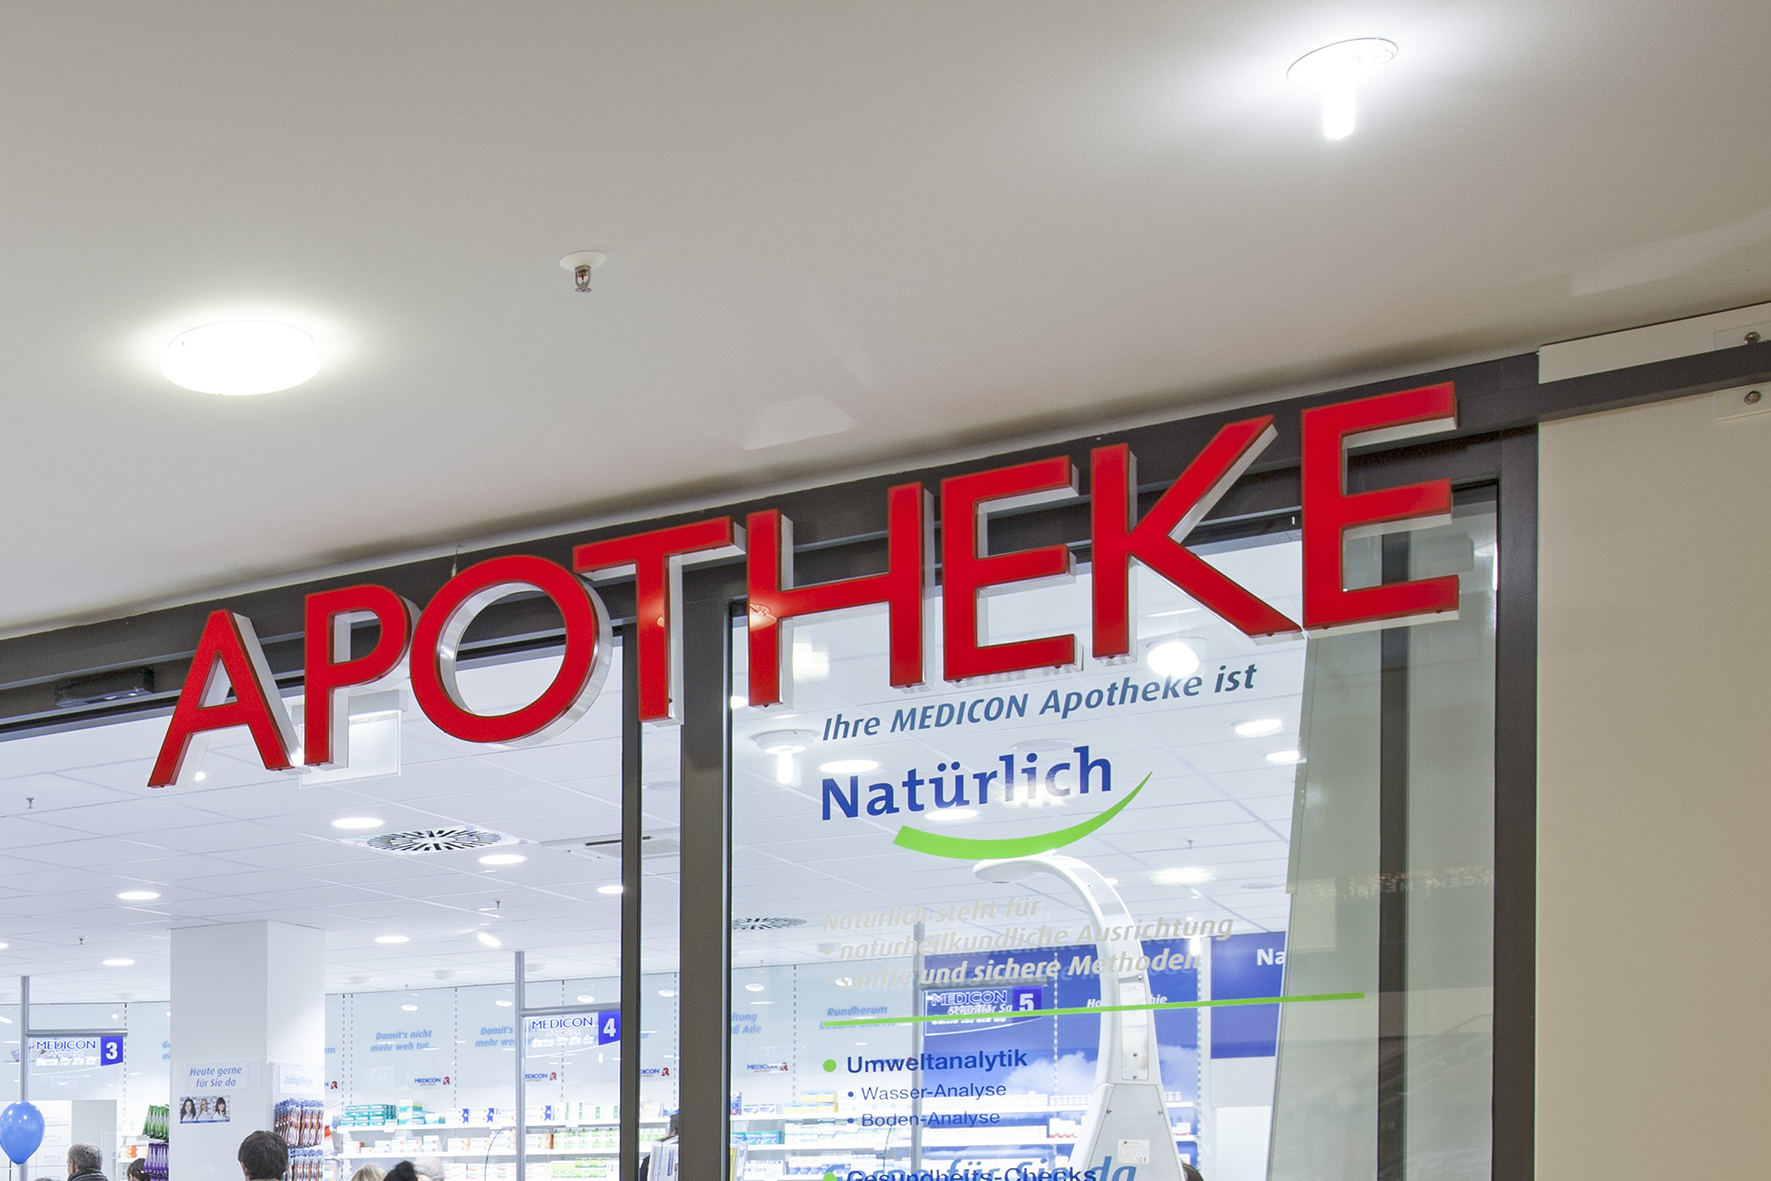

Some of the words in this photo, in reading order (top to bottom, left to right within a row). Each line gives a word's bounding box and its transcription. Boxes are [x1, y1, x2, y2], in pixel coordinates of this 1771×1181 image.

[147, 388, 1460, 790] APOTHEKE
[822, 713, 881, 741] Ihre
[890, 693, 1028, 733] MEDICON
[1039, 673, 1203, 719] Apotheke
[1214, 663, 1257, 694] ist
[821, 745, 1112, 821] Natürlich
[1076, 917, 1234, 943] Ausrichtung
[920, 960, 968, 984] und
[971, 957, 1061, 981] sichere
[1068, 948, 1202, 976] Methoden
[827, 1005, 888, 1017] Rundherum
[931, 990, 1008, 1006] MEDICON
[1019, 993, 1035, 1012] 5
[532, 1017, 593, 1030] MEDICON
[603, 1018, 617, 1037] 4
[36, 1040, 96, 1050] MEDICON
[105, 1041, 118, 1060] 3
[501, 1038, 516, 1047] we
[847, 1049, 1028, 1073] Umweltanalytik
[189, 1067, 216, 1077] Heute
[217, 1066, 243, 1077] gerne
[195, 1078, 208, 1088] für
[210, 1077, 223, 1087] Sie
[225, 1077, 236, 1087] da
[861, 1083, 1007, 1101] Wasser-Analyse
[861, 1111, 1000, 1127] Boden-Analyse
